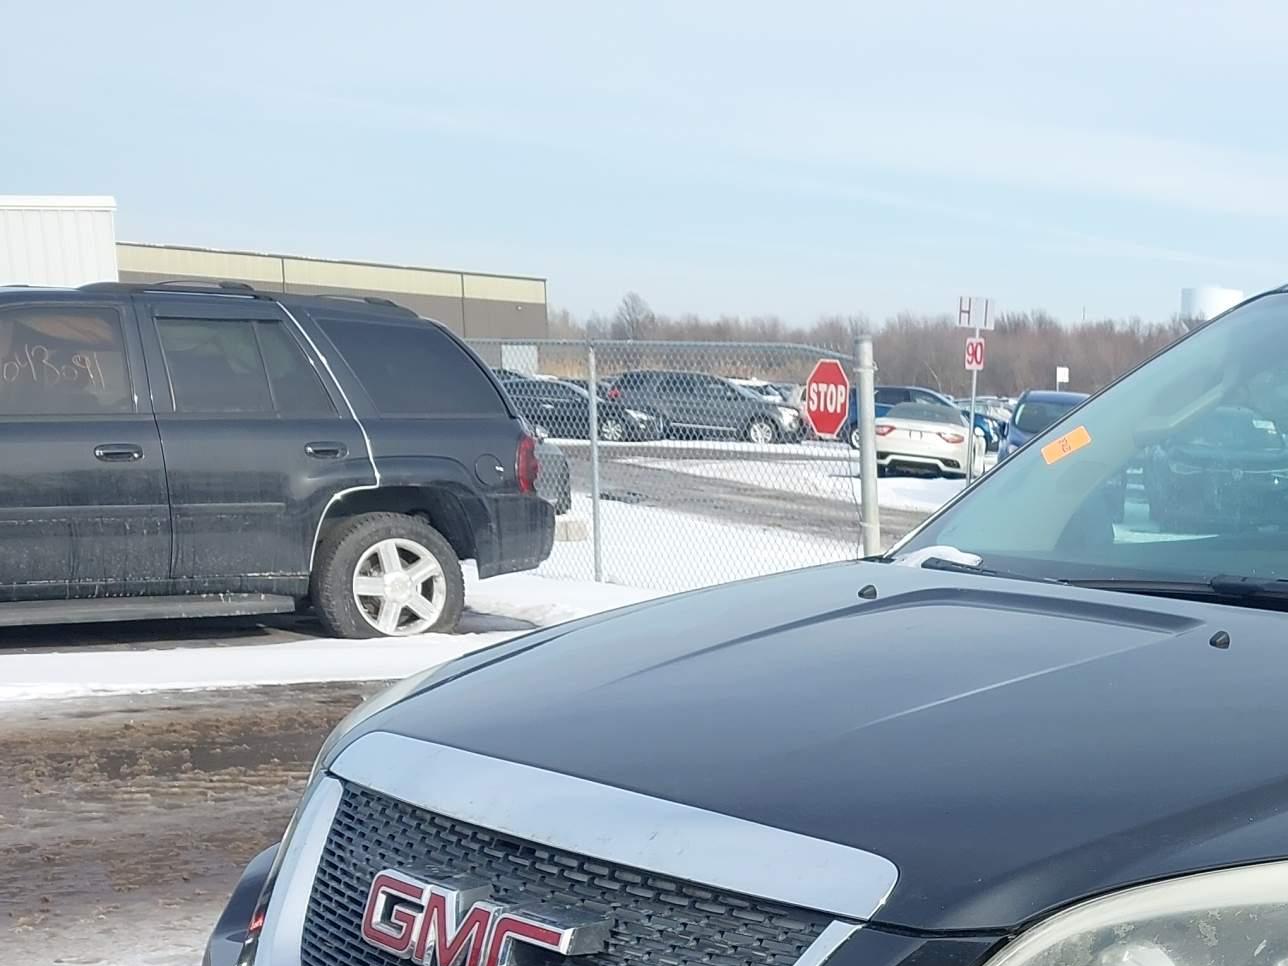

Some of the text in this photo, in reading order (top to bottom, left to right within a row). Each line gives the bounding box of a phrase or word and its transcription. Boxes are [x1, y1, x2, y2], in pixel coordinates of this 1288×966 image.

[959, 296, 971, 325] H
[966, 342, 984, 365] 90
[808, 383, 846, 414] STOP
